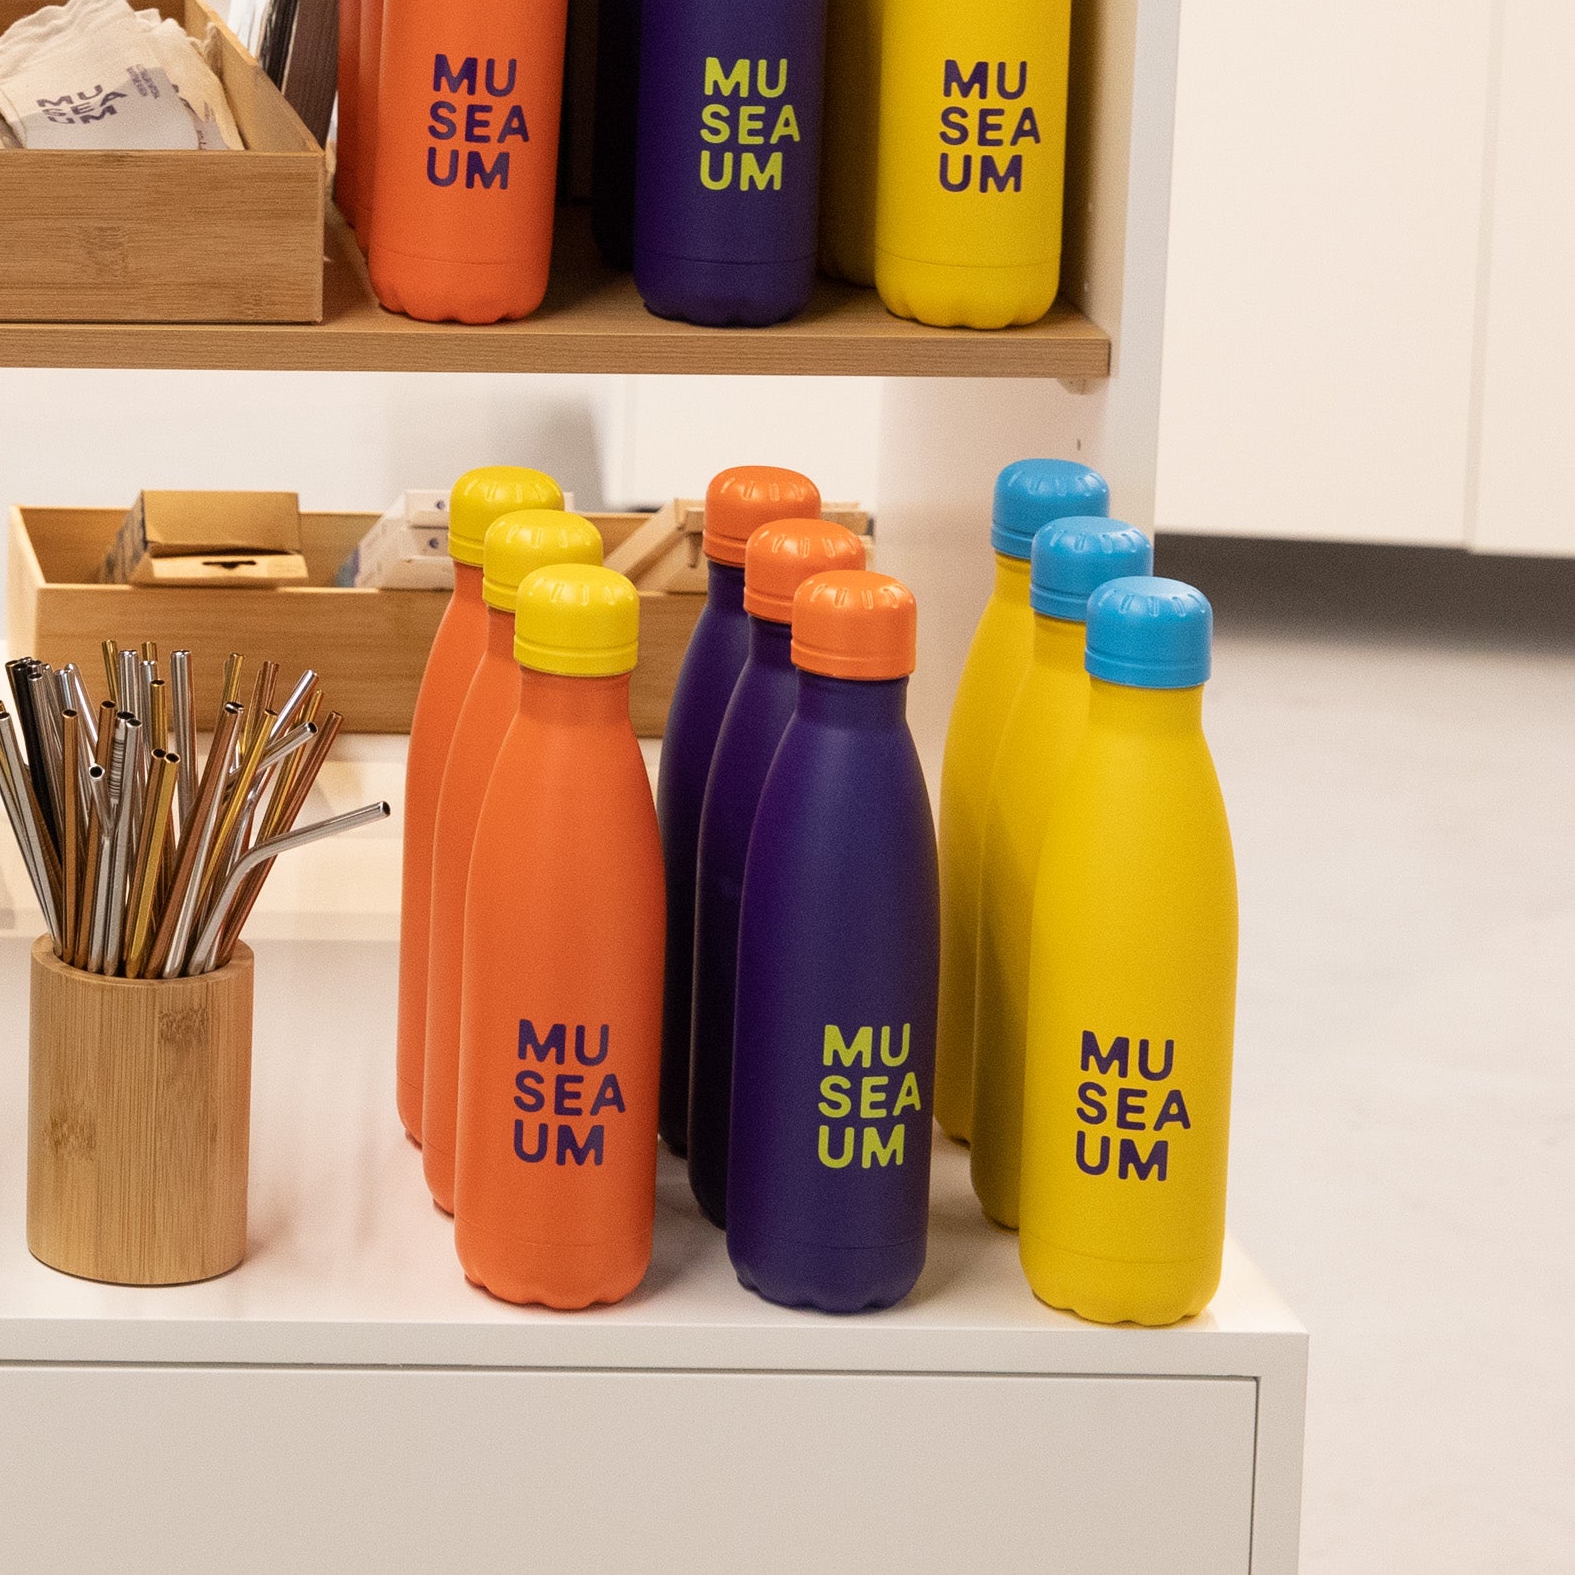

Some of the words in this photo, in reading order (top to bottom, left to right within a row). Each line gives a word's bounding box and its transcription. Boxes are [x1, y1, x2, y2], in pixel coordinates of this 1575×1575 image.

[432, 53, 517, 98] MU
[704, 56, 788, 98] MU
[943, 59, 1028, 100] MU
[427, 100, 530, 144] SEA
[699, 105, 800, 145] SEA
[939, 105, 1041, 147] SEA
[426, 145, 511, 190] UM
[699, 150, 784, 191] UM
[938, 152, 1024, 193] UM
[517, 1018, 610, 1067] MU
[822, 1022, 912, 1068] MU
[1079, 1029, 1175, 1082] MU
[513, 1069, 626, 1120] SEA
[817, 1072, 922, 1119] SEA
[1076, 1081, 1192, 1132] SEA
[512, 1118, 605, 1166] UM
[817, 1124, 906, 1170] UM
[1075, 1130, 1169, 1182] UM
